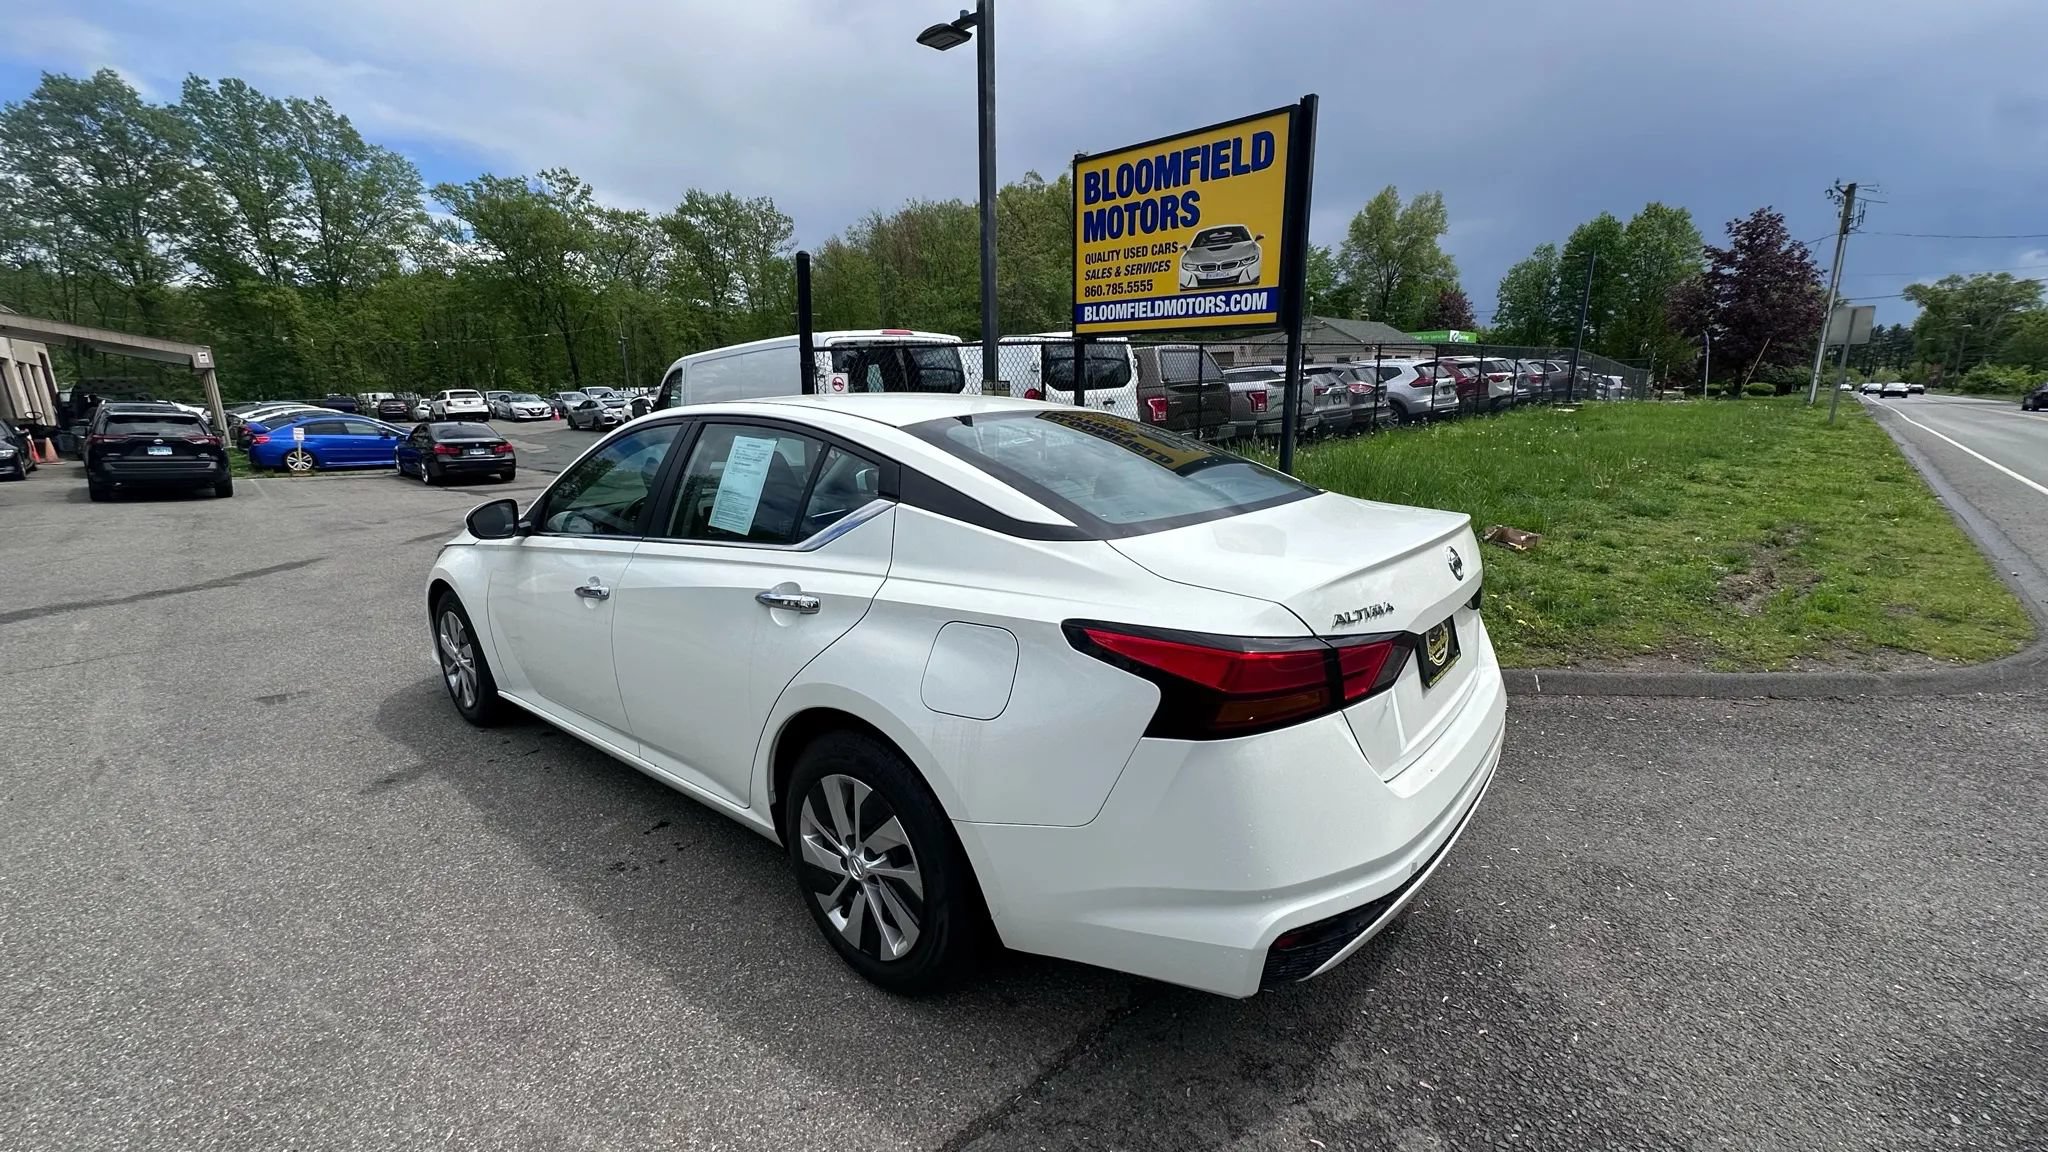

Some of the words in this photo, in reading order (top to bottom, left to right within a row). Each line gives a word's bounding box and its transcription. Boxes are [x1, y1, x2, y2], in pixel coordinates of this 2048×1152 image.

[1084, 130, 1276, 205] BLOOMFIELD
[1083, 190, 1201, 243] MOTORS
[1085, 249, 1121, 265] QUALITY
[1123, 245, 1148, 260] USED
[1151, 241, 1178, 256] CARS
[1085, 267, 1112, 281] SALES
[1114, 265, 1121, 278] &
[1124, 259, 1171, 277] SERVICES
[1084, 279, 1153, 298] 860.785.5555
[1083, 291, 1268, 323] BLOOMFIELDMOTORS.COM
[1331, 601, 1394, 628] ALTIMA
